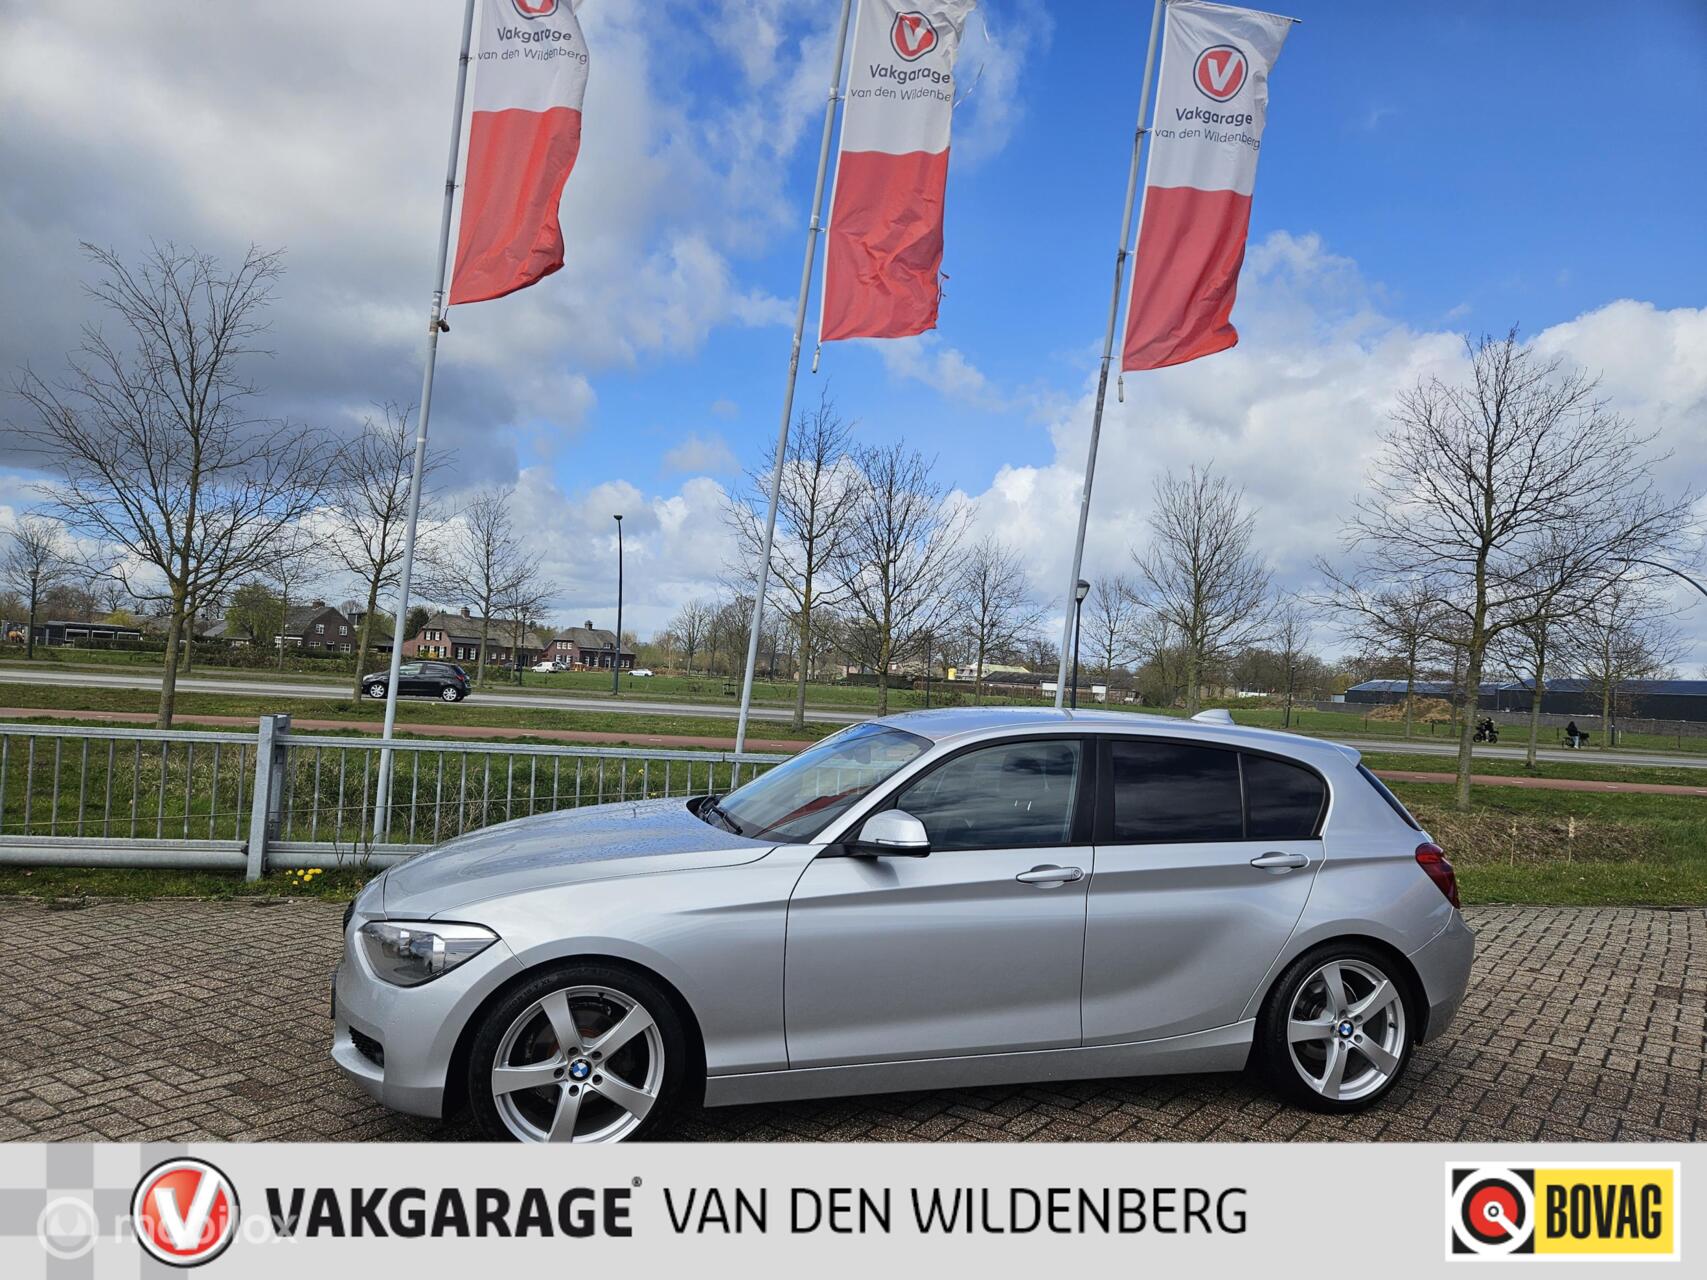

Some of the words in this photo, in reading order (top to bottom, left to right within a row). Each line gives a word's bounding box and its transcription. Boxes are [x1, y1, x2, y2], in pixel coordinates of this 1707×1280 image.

[497, 27, 572, 43] Vakgarage
[478, 51, 498, 60] van
[501, 48, 520, 60] den
[524, 46, 588, 65] Wildenberg
[870, 63, 951, 85] Vakgarage
[850, 88, 872, 98] van
[874, 86, 897, 99] den
[900, 88, 952, 102] Wildenbe
[1175, 106, 1254, 127] Vakgarage
[1154, 129, 1175, 139] van
[1179, 128, 1201, 139] den
[1204, 128, 1261, 151] Wildenberg
